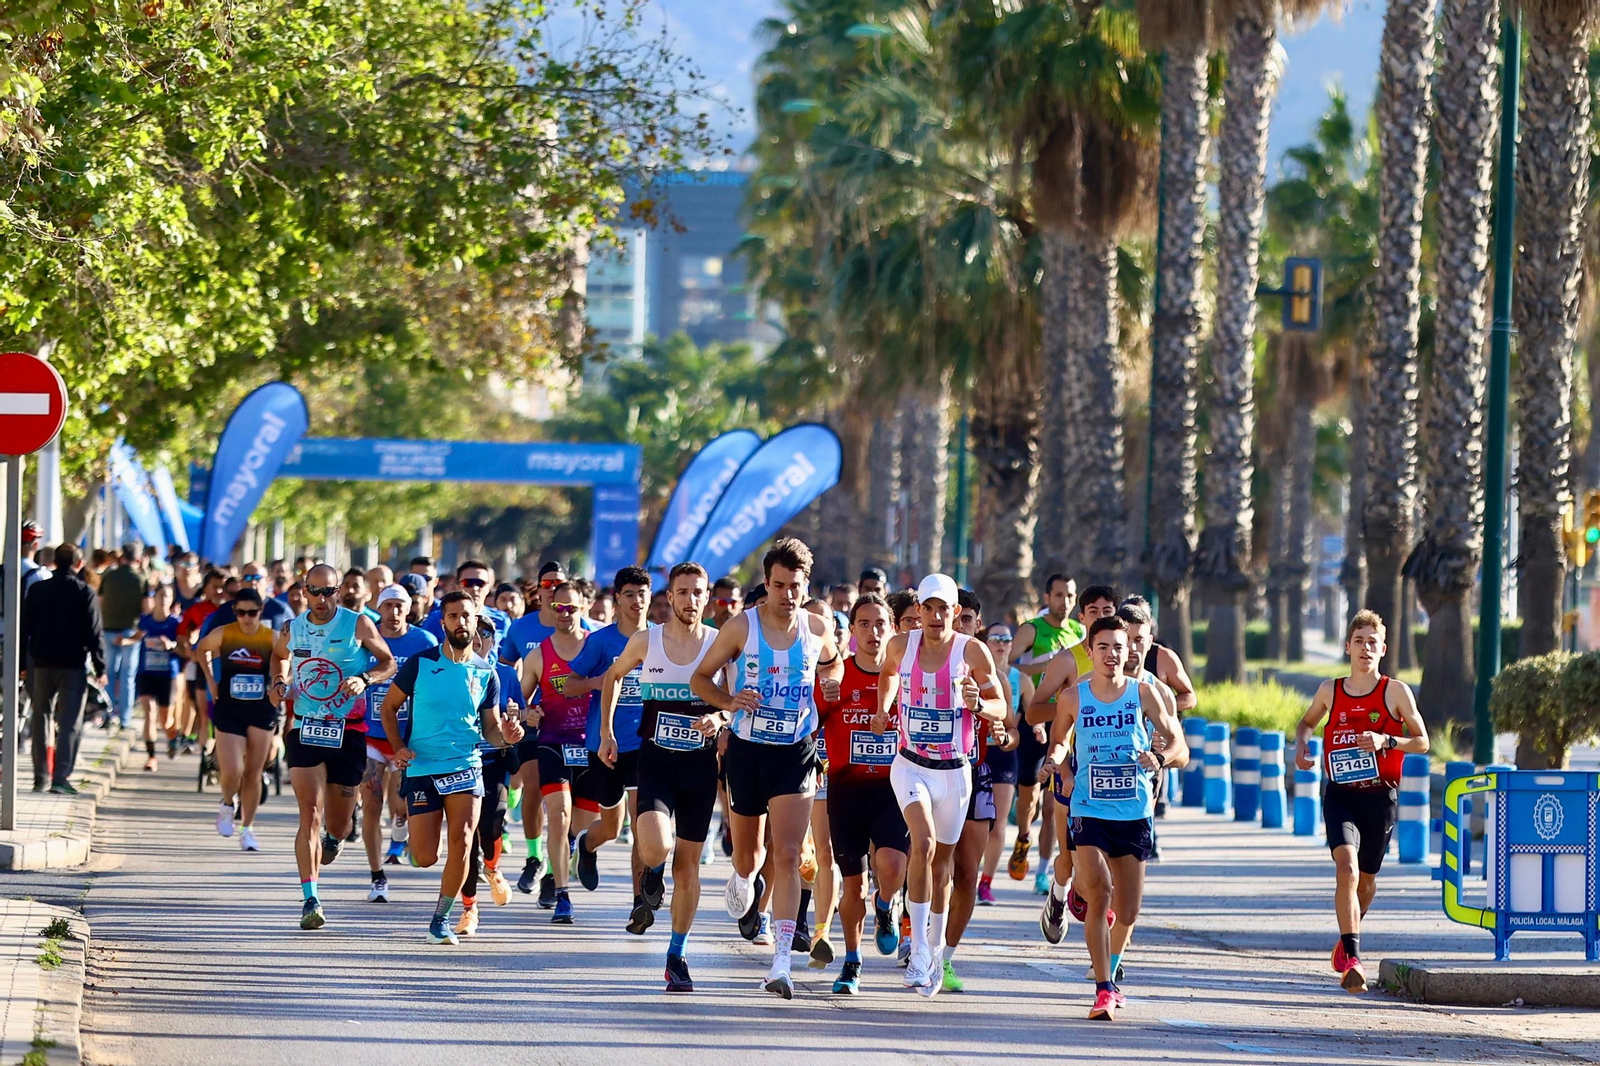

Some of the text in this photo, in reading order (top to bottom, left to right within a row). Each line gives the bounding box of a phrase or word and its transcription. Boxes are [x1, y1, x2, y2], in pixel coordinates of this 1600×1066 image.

[213, 411, 287, 526] mayoral
[527, 450, 625, 476] mayoral
[708, 452, 816, 558] mayoral
[765, 720, 785, 732] 26
[1083, 710, 1135, 729] nerja
[306, 726, 338, 737] 1669
[662, 726, 700, 740] 1992
[920, 721, 940, 732] 25
[1092, 730, 1129, 739] ATLETISMO
[857, 744, 892, 754] 1681
[1335, 758, 1371, 772] 2149
[438, 770, 471, 785] 1955
[1095, 777, 1133, 788] 2156
[1509, 916, 1584, 926] POLICÍA LOCAL MÁLAGA
